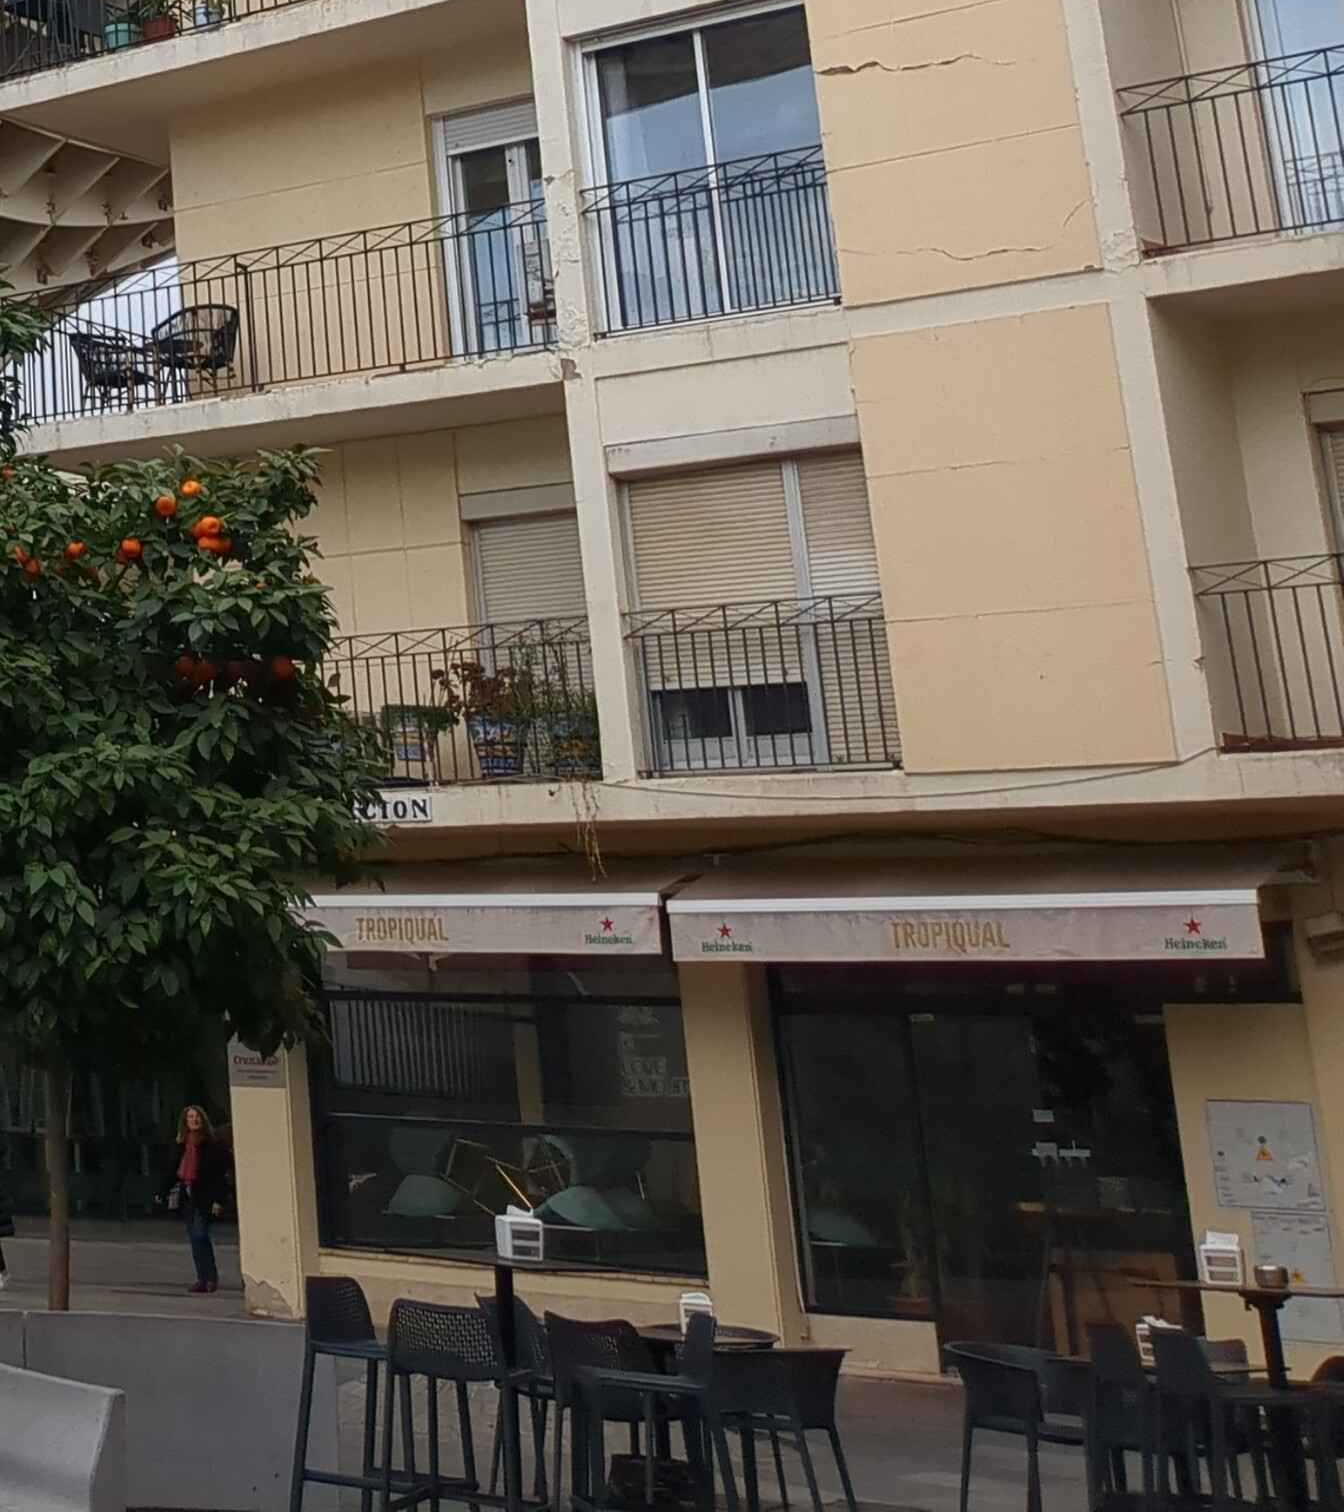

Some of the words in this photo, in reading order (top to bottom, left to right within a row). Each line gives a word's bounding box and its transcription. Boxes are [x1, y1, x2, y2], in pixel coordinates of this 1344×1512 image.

[355, 917, 449, 944] TROPIQUAL
[891, 920, 1011, 953] TROPIQUAL
[584, 934, 633, 944] Heineken
[701, 940, 753, 952] Heineken
[1163, 936, 1228, 950] Heineken
